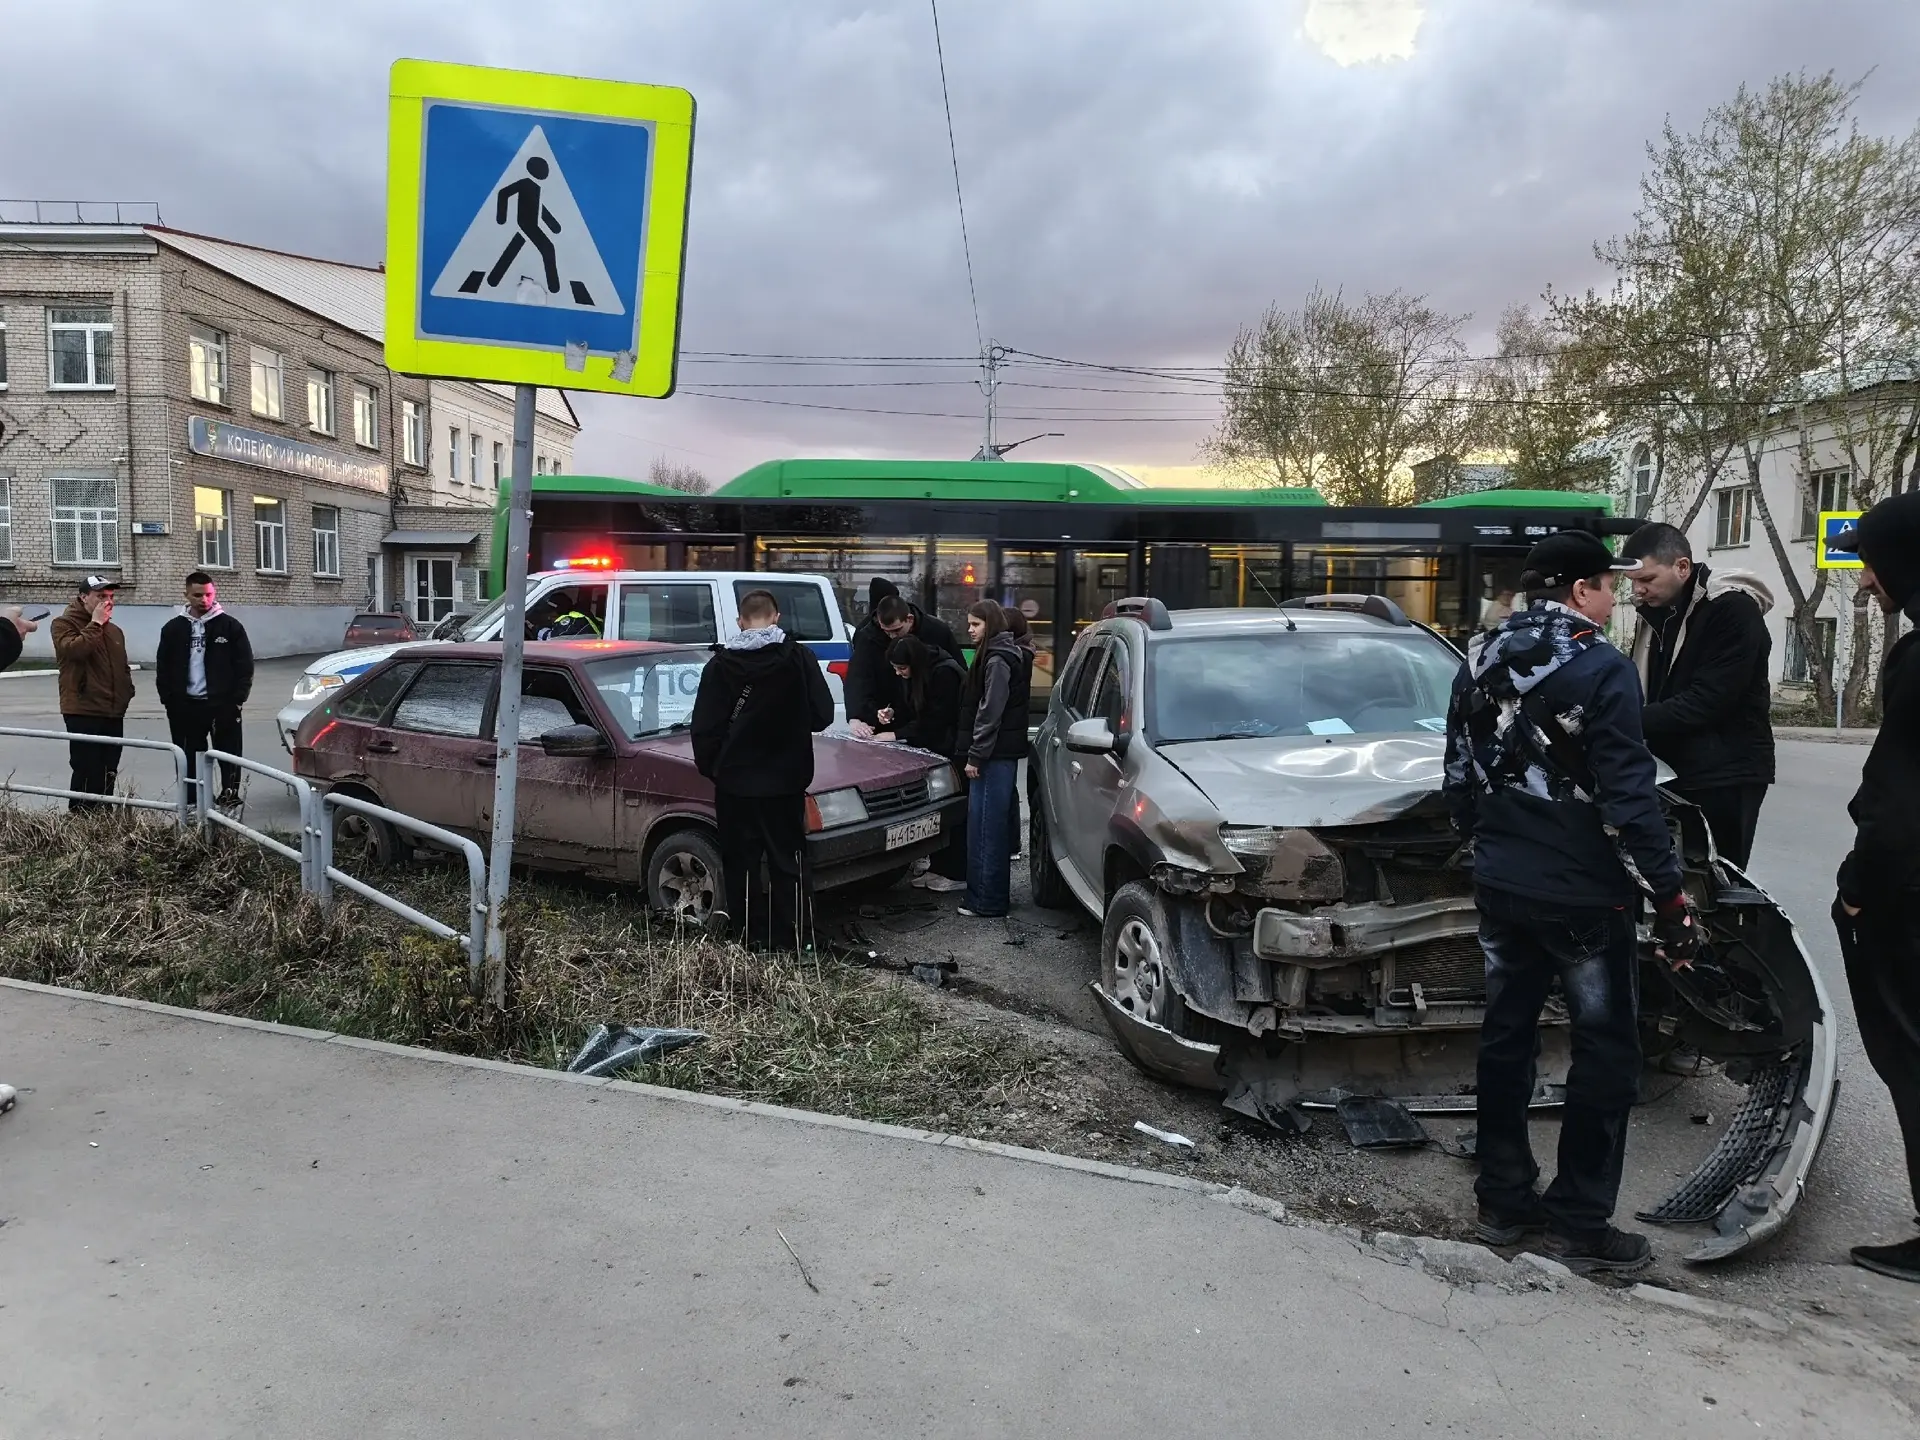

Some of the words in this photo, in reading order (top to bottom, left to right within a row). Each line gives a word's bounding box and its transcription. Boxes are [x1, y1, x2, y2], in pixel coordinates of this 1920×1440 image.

[227, 434, 294, 463] КОПЕЙСКИЙ
[297, 452, 350, 477] МОЛОЧНЫЙ
[353, 465, 381, 485] ЗАВОД
